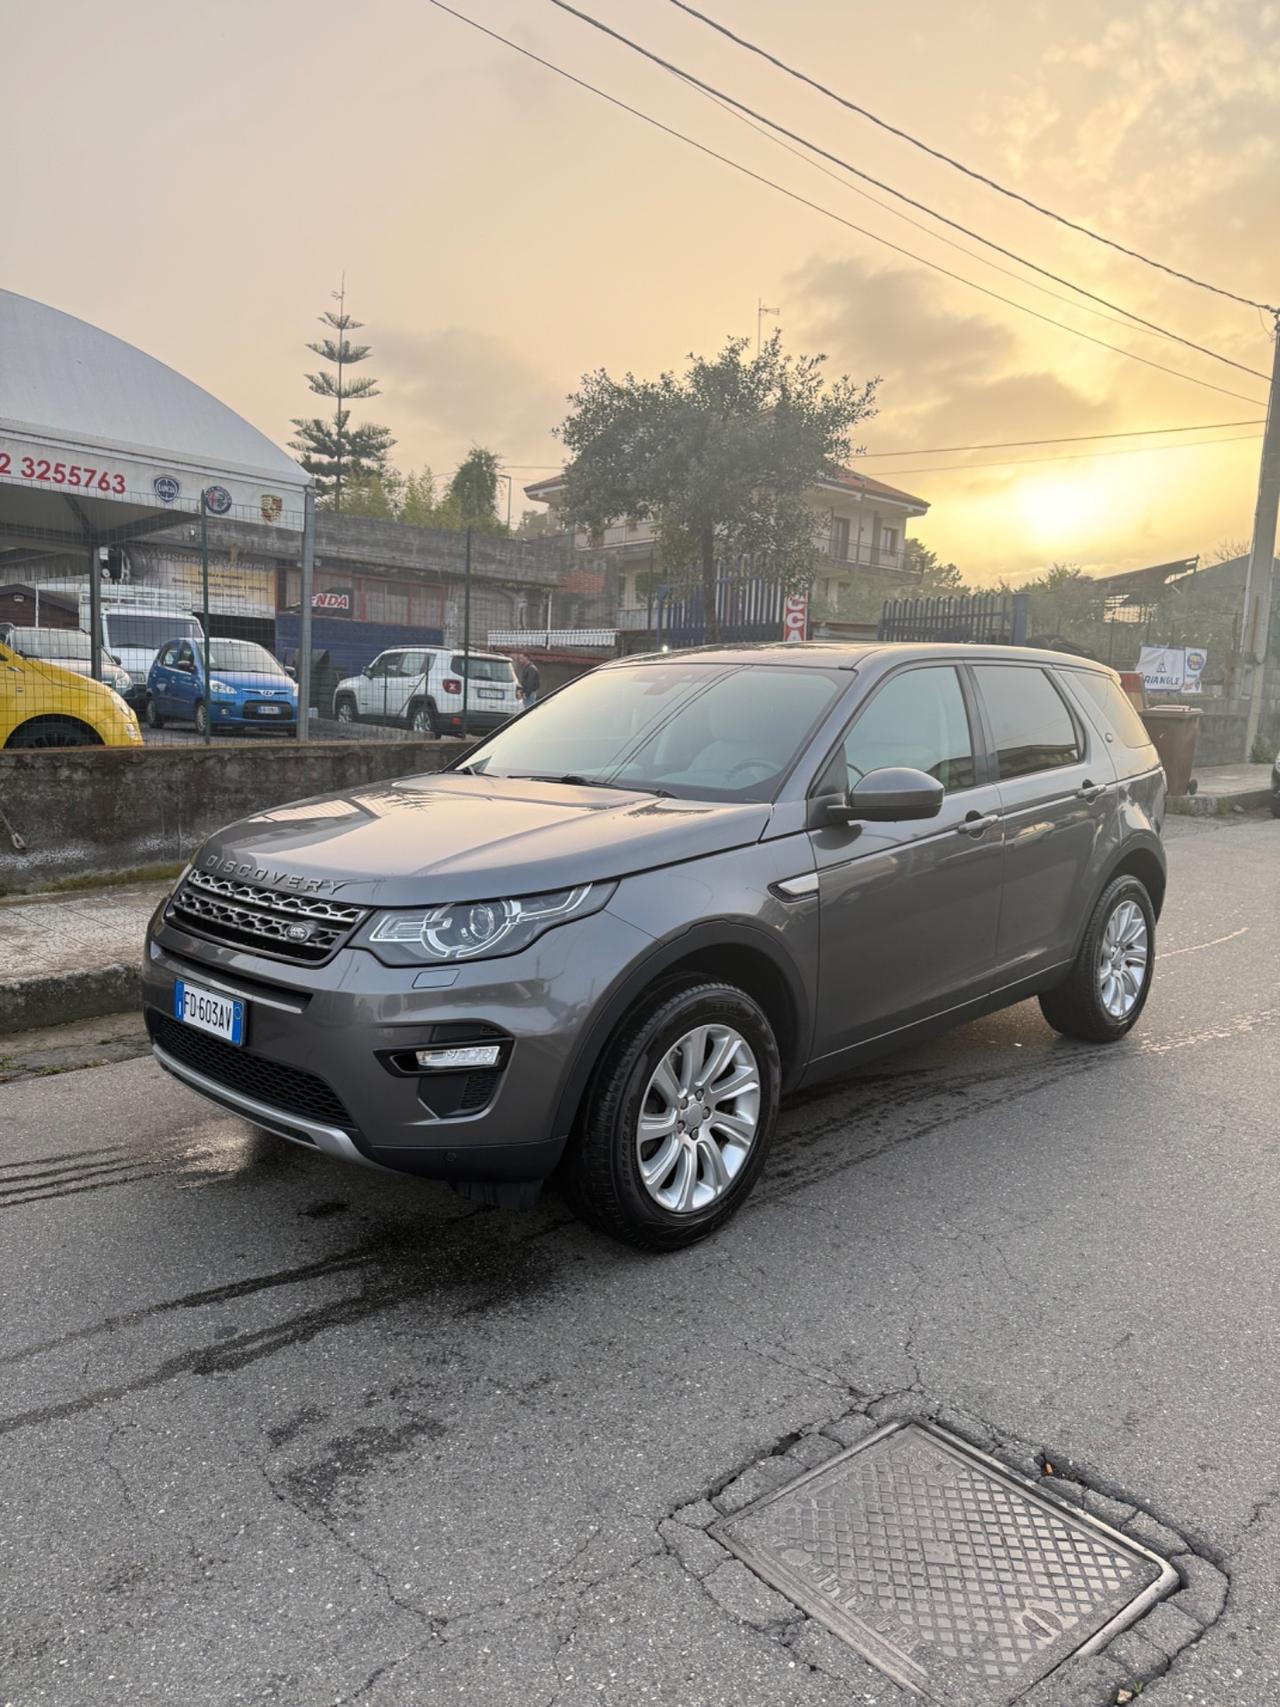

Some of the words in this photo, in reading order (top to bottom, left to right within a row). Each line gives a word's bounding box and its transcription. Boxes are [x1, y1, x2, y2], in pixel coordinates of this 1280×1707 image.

[21, 456, 126, 494] 3255763
[1144, 675, 1181, 686] RIANGLE
[206, 854, 348, 896] DISCOVERY
